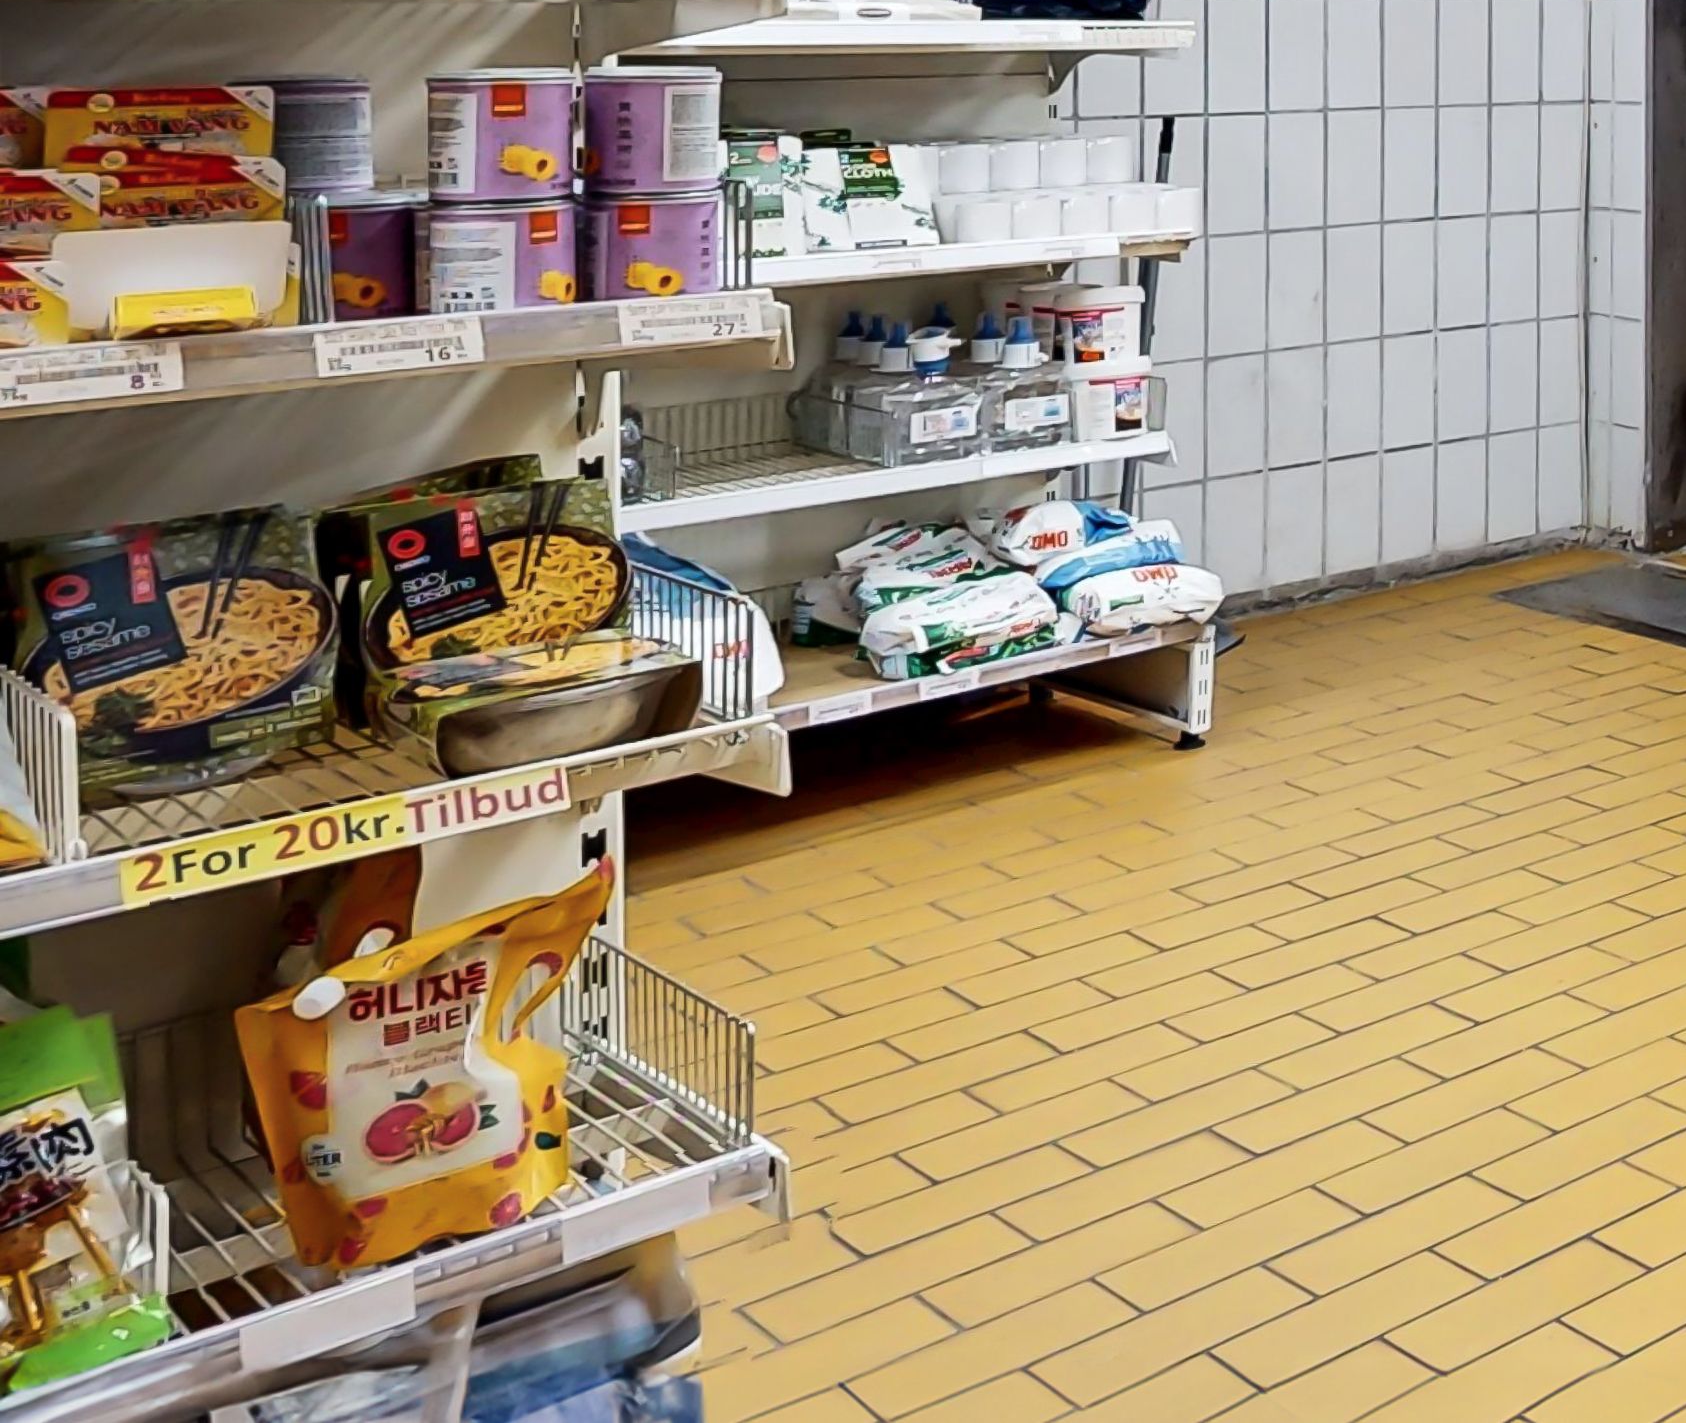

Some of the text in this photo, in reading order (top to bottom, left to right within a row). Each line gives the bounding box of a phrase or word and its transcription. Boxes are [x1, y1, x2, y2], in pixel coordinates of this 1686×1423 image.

[712, 324, 735, 336] 27
[401, 569, 447, 593] spicy
[60, 617, 117, 645] spicy
